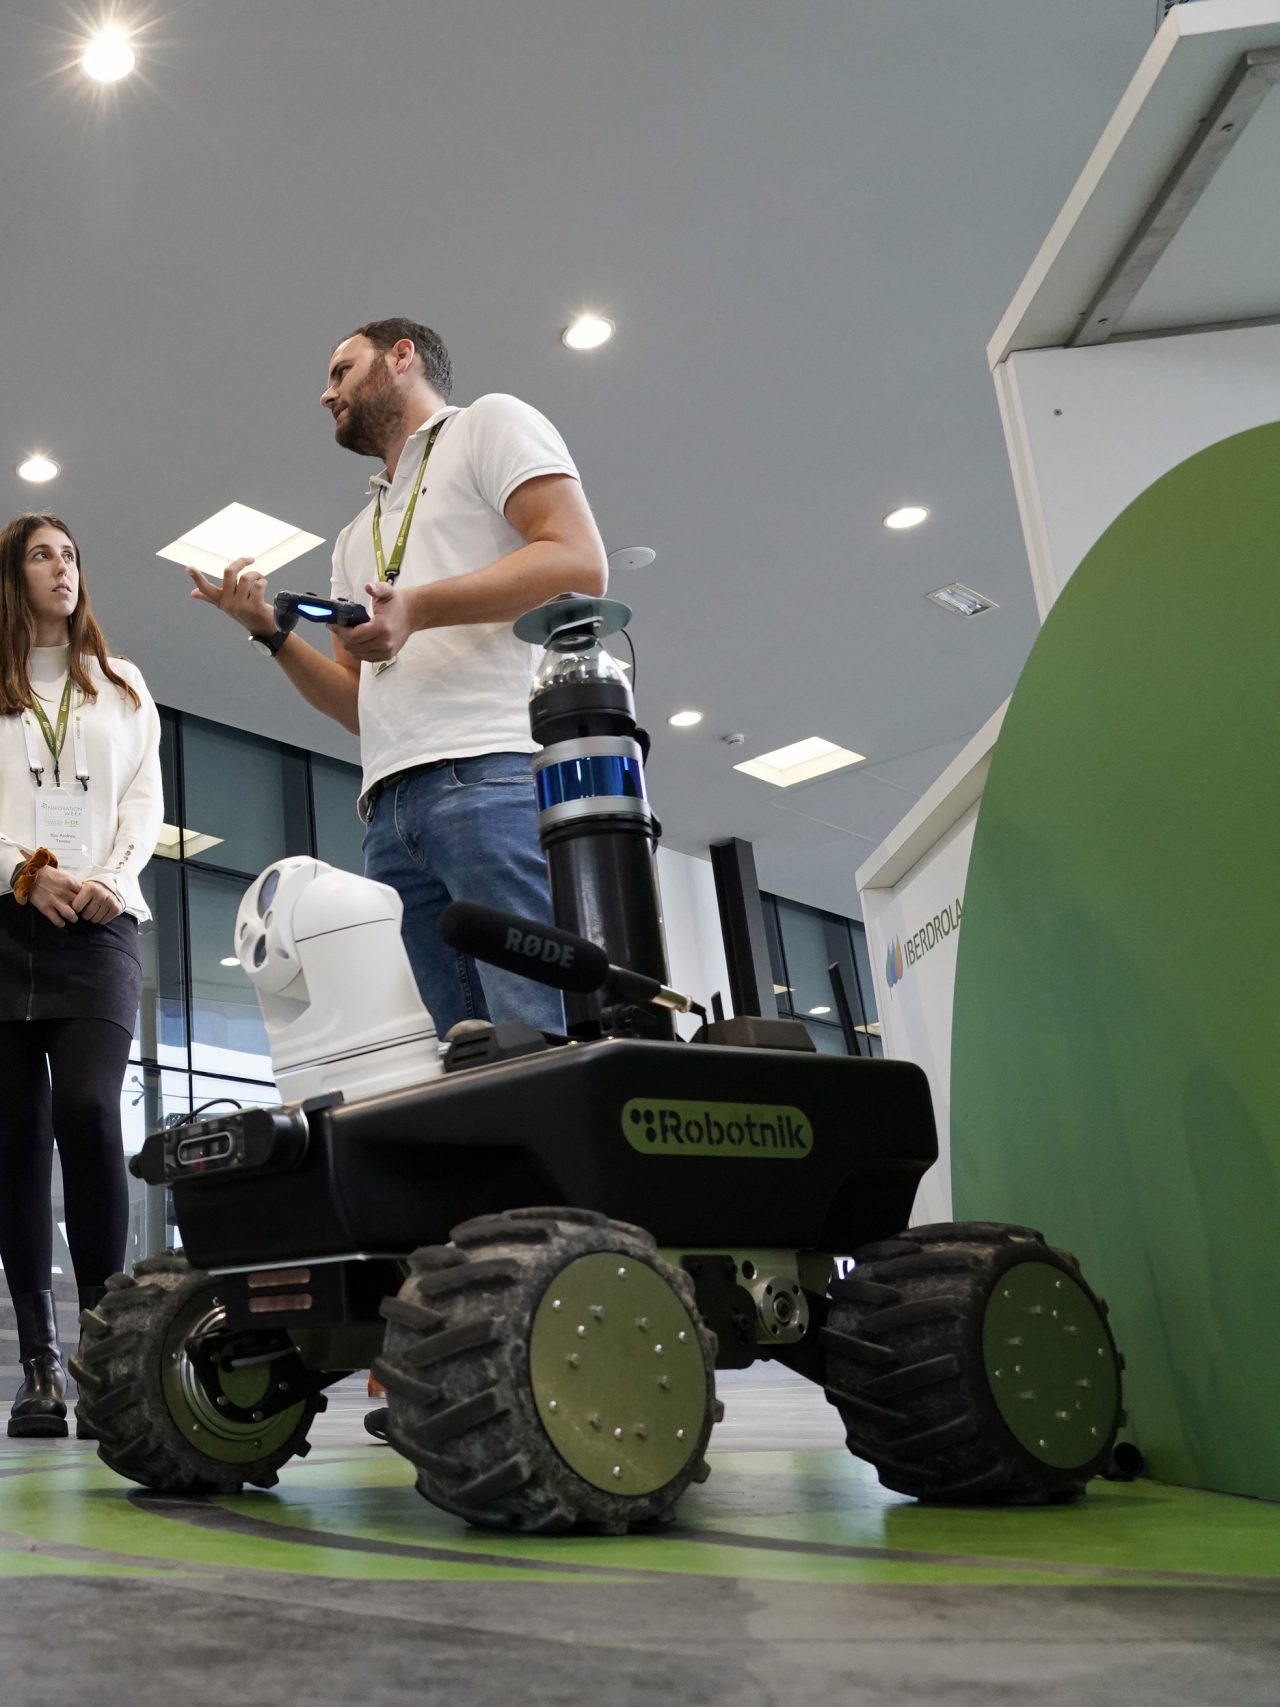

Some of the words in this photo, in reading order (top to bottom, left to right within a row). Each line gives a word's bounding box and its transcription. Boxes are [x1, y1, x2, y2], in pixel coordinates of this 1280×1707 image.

[503, 926, 575, 969] RØDE
[903, 897, 963, 969] IBERDROLA
[658, 1109, 808, 1149] Robotnik
